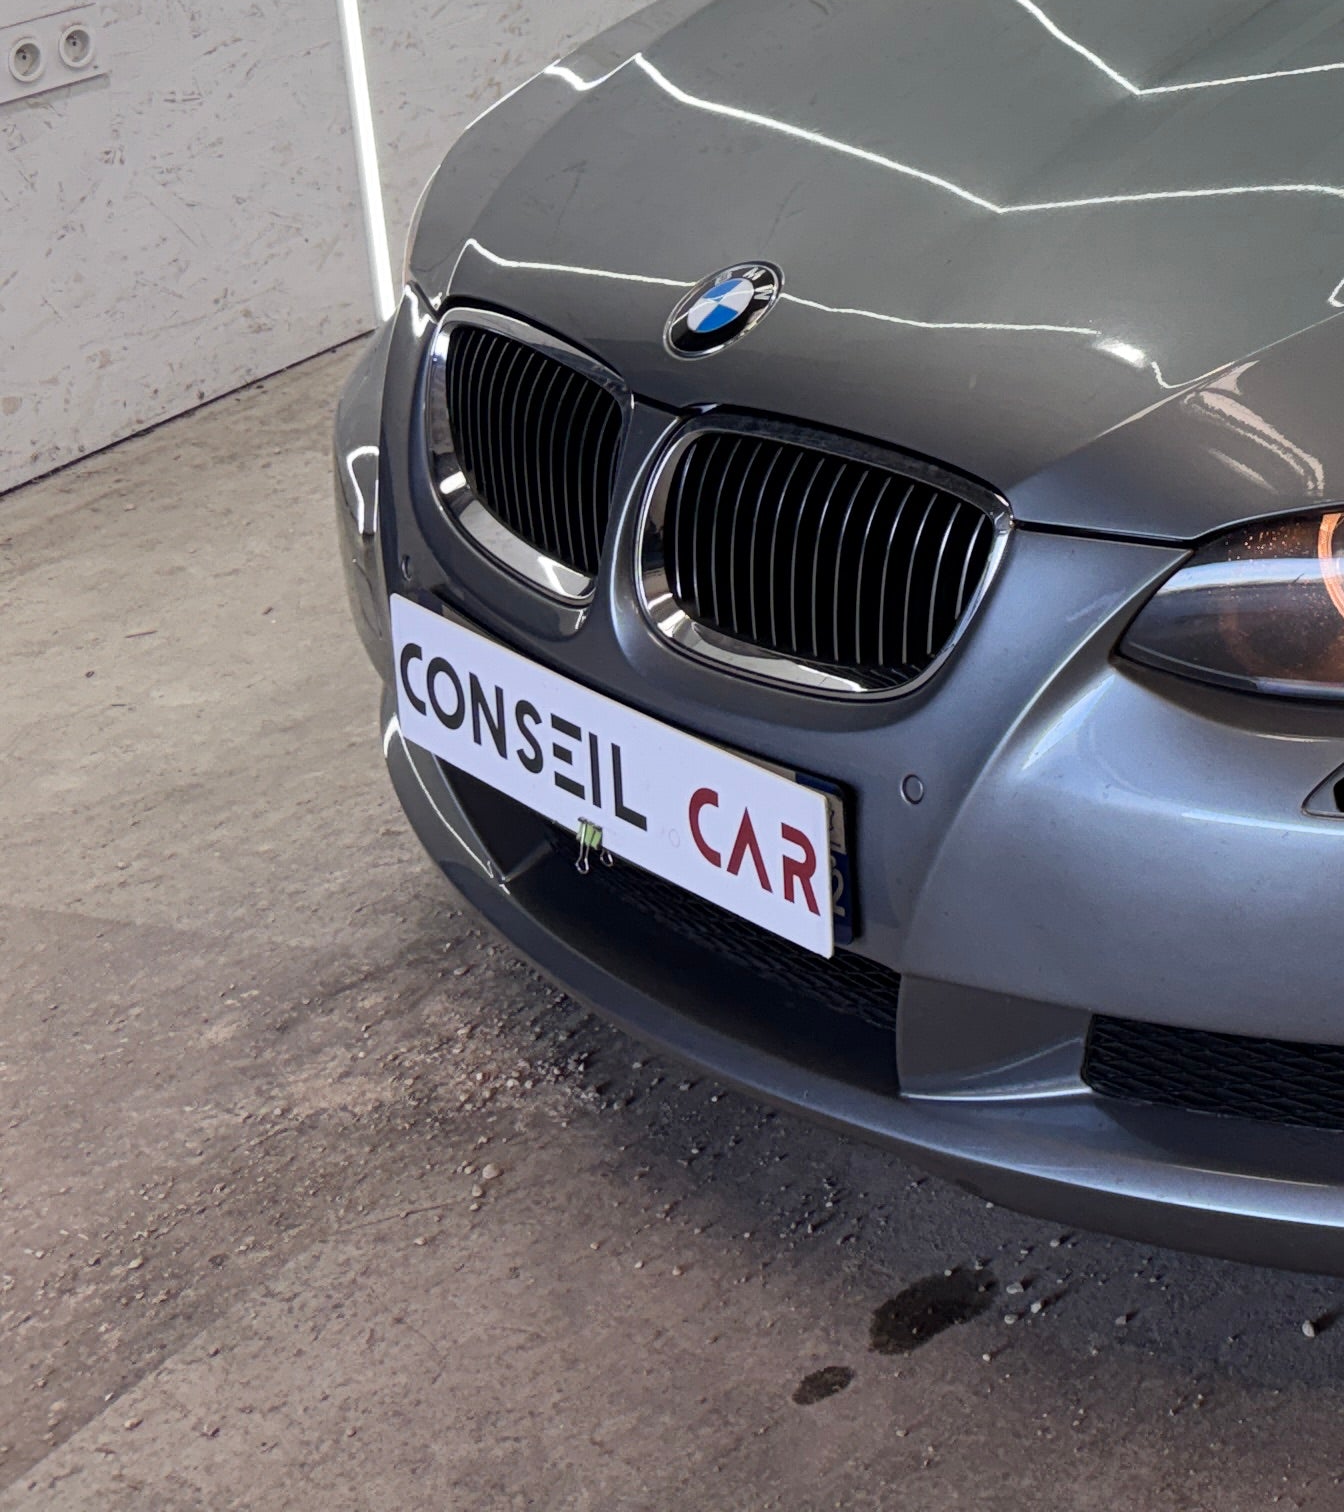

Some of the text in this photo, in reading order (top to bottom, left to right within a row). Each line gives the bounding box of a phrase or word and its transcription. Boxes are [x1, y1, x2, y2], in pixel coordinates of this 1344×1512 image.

[714, 266, 775, 301] BMW
[399, 641, 648, 833] CONSEIL
[688, 787, 821, 917] CAR
